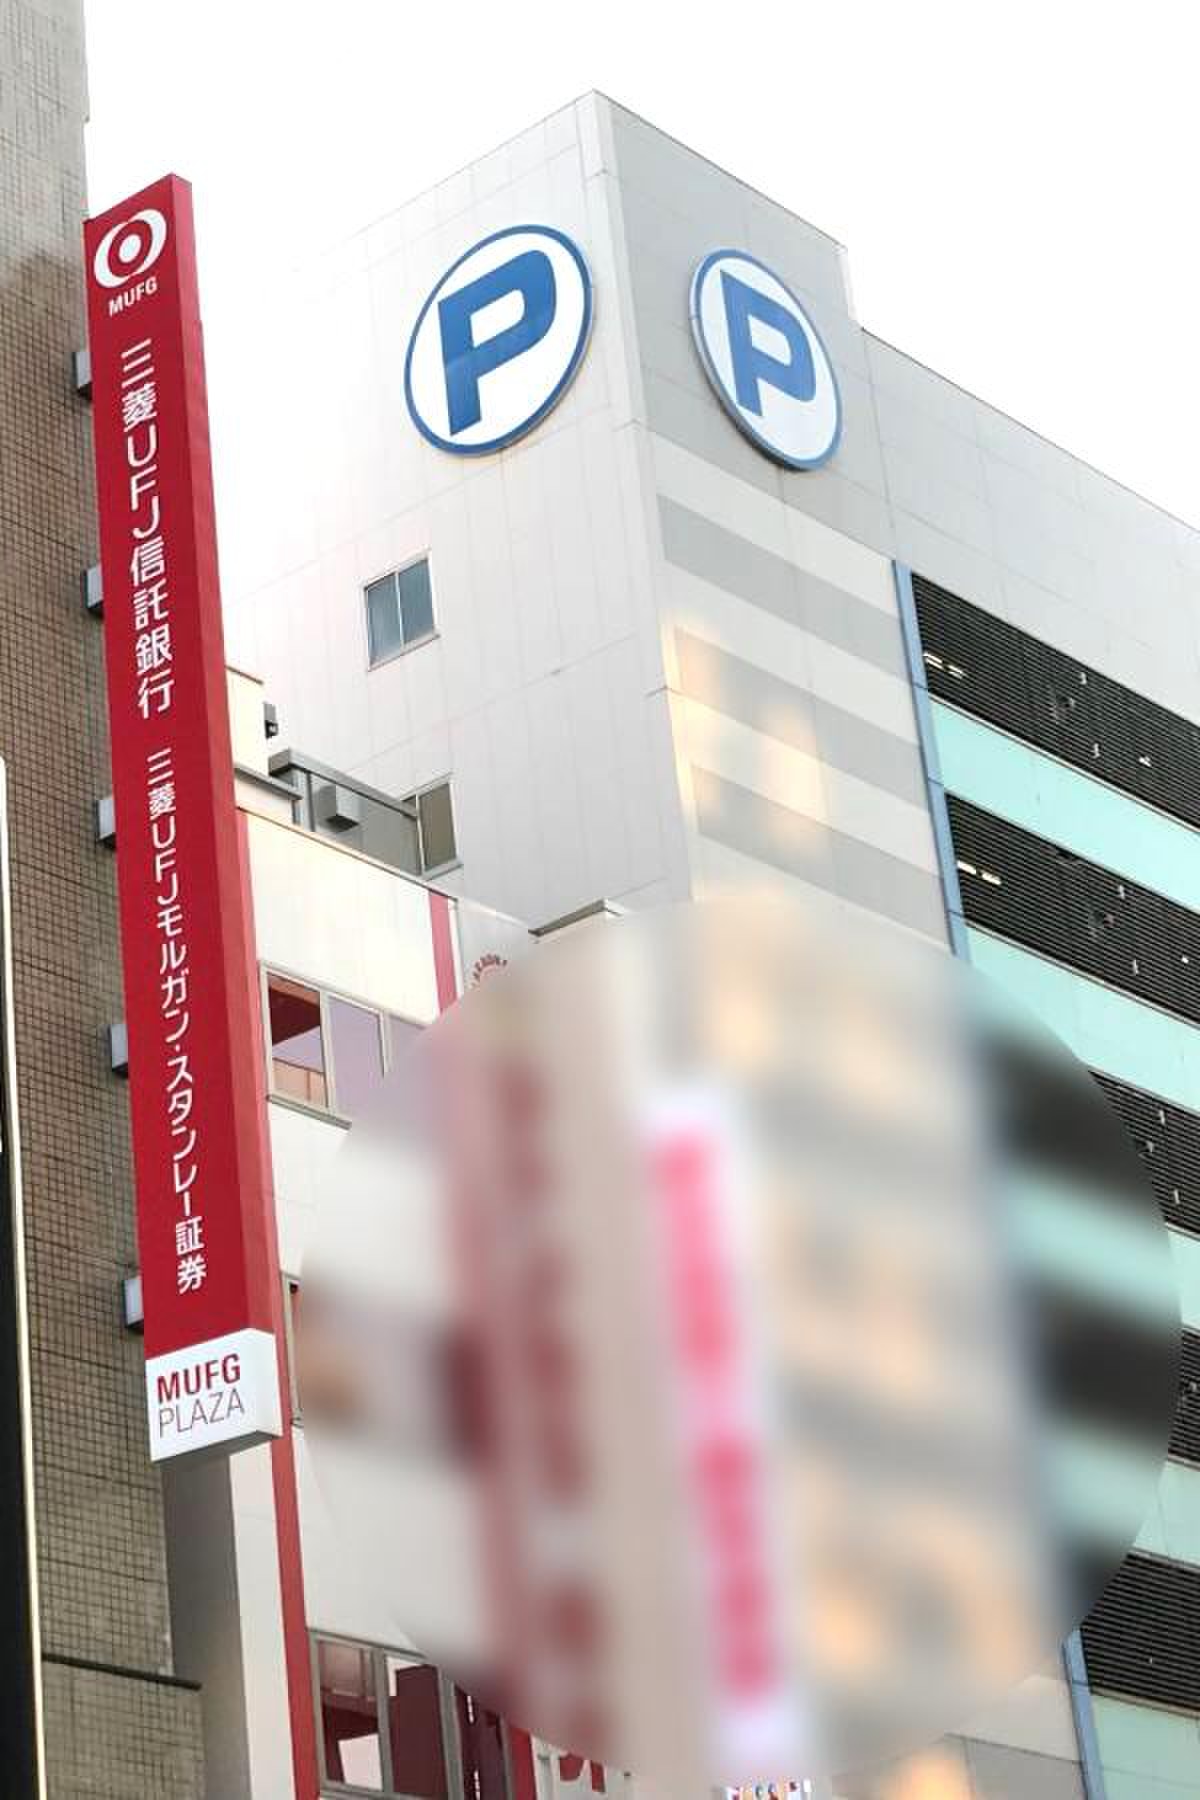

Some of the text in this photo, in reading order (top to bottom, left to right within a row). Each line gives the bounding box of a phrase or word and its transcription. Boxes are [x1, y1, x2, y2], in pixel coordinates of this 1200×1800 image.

[108, 276, 158, 317] MUFG
[438, 250, 557, 436] P
[720, 269, 817, 417] P
[121, 338, 175, 719] 三菱UFJ信託銀行
[157, 1353, 240, 1403] MUFG
[159, 1387, 245, 1438] PLAZA
